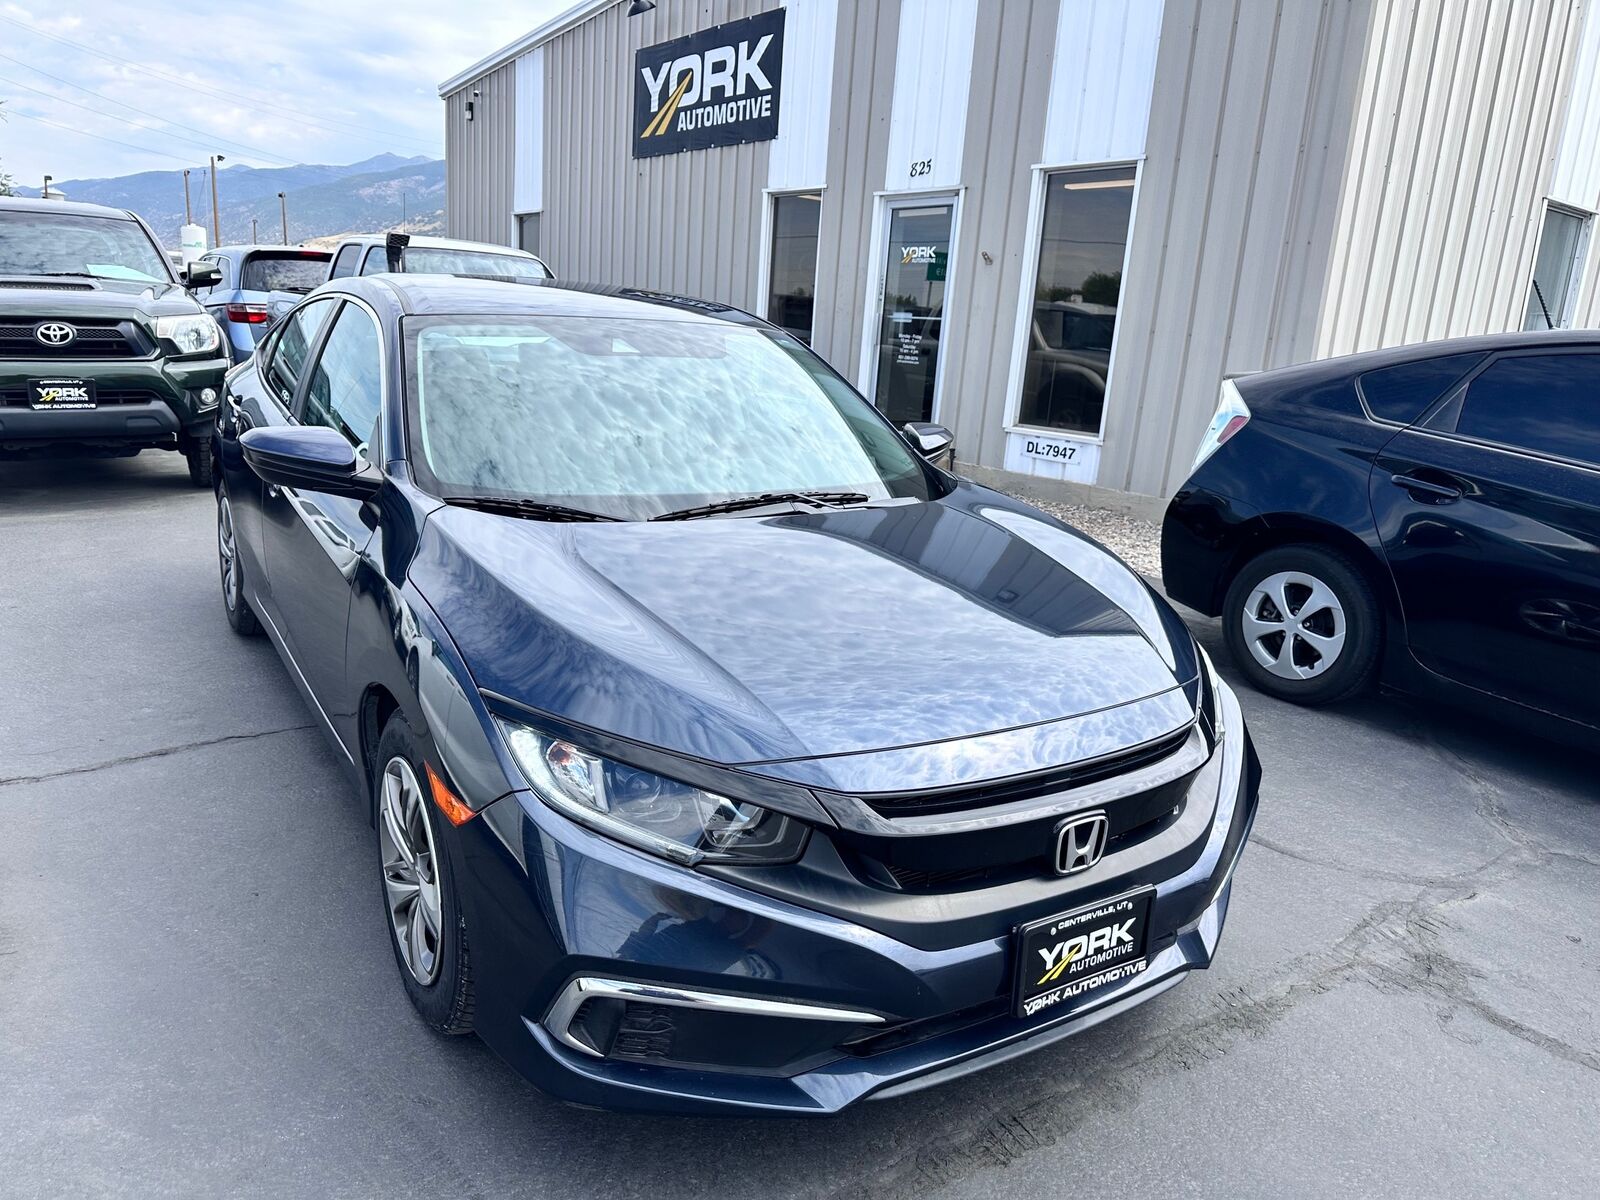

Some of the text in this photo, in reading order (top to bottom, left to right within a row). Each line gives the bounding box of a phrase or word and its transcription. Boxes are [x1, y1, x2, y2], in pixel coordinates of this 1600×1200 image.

[641, 34, 774, 112] YORK
[677, 95, 771, 132] AUTOMOTIVE
[910, 158, 932, 177] 825
[901, 246, 936, 258] YORK
[36, 387, 88, 397] YORK
[1026, 441, 1076, 460] DL:7947
[1038, 917, 1136, 971] YORK
[1069, 942, 1133, 974] AUTOMOTIVE
[1063, 960, 1147, 999] AUTOMOTIVE
